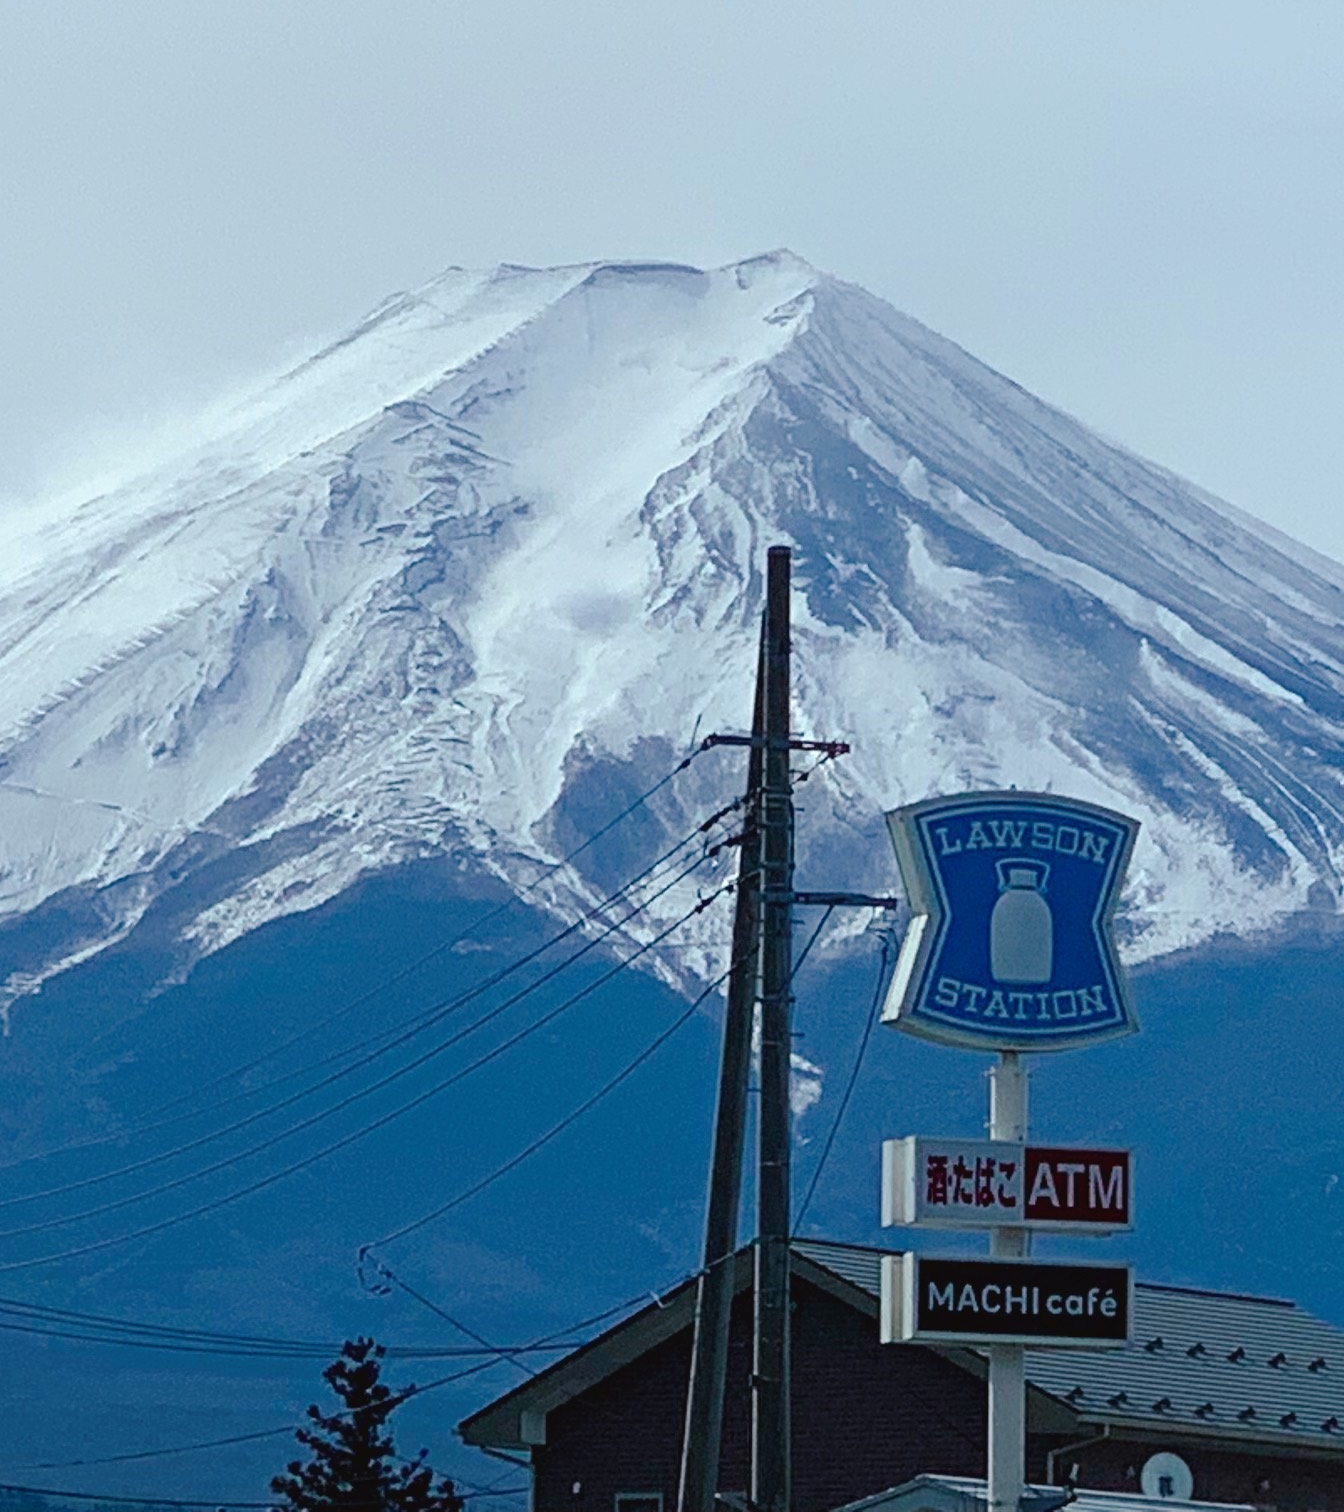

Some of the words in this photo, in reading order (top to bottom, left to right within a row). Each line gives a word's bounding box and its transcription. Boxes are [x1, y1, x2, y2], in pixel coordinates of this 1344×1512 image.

[935, 820, 1110, 864] LAWSON
[934, 976, 1109, 1022] STATION
[1028, 1162, 1124, 1210] ATM
[927, 1281, 1039, 1315] MACHI
[1046, 1287, 1117, 1317] café
